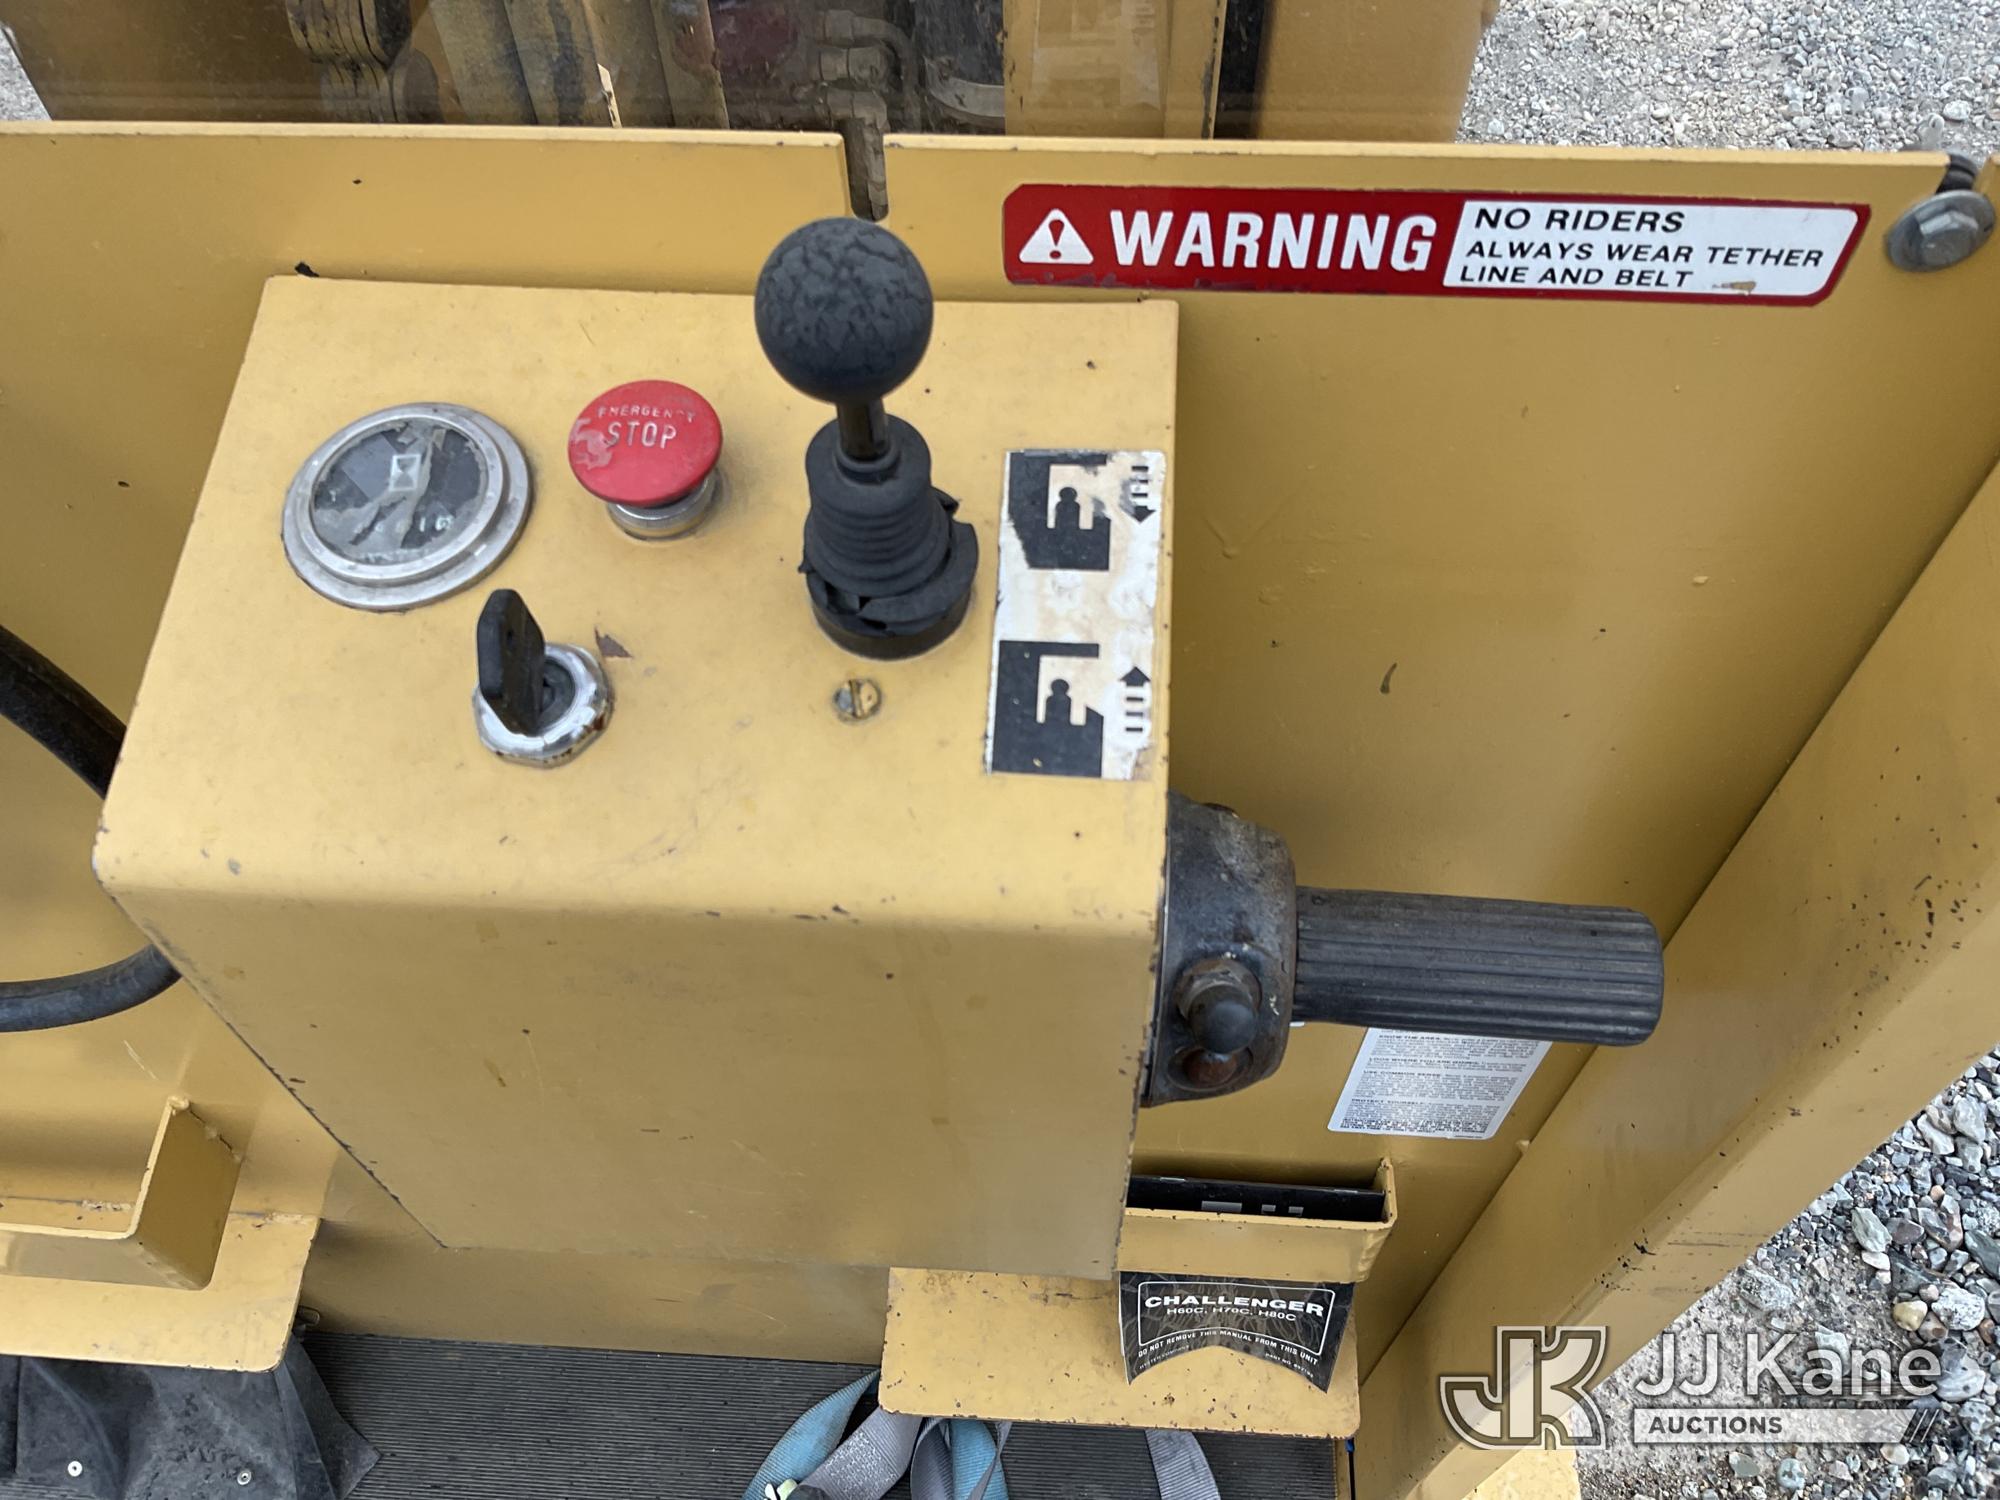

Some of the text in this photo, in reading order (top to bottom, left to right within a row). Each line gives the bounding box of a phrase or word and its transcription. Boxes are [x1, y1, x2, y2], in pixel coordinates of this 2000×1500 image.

[1474, 207, 1686, 233] NO RIDERS
[1110, 209, 1438, 272] WARNING
[1466, 240, 1824, 268] ALWAYS WEAR TETHER
[1460, 265, 1694, 288] LINE AND BELT
[607, 420, 678, 449] STOP
[1145, 1295, 1324, 1317] CHALLENGER
[1167, 1306, 1297, 1322] H60C, H70C, H80C
[1138, 1348, 1148, 1358] DO
[1149, 1340, 1165, 1352] NOT
[1166, 1332, 1196, 1345] REMOVE
[1219, 1330, 1252, 1342] MANUAL
[1255, 1337, 1278, 1349] FROM
[1280, 1344, 1298, 1356] THIS
[1300, 1352, 1318, 1366] UNIT
